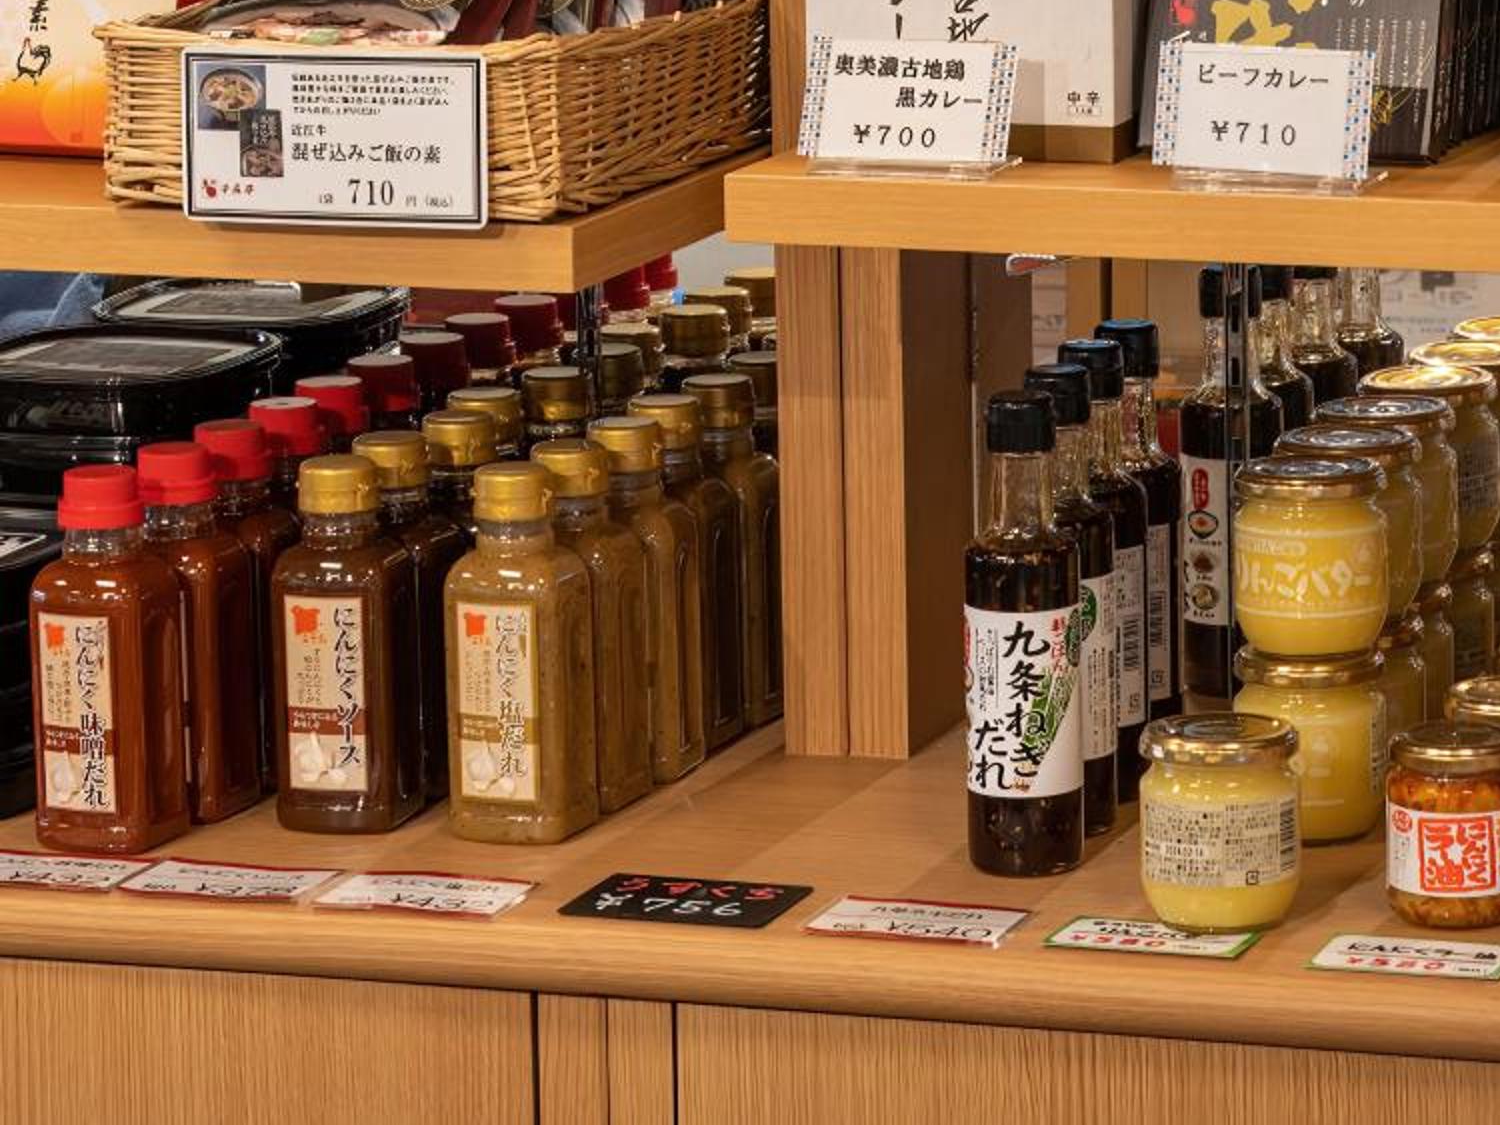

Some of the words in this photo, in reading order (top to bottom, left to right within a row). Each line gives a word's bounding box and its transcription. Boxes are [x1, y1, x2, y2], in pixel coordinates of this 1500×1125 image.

[835, 53, 965, 80] 奥美濃古地鶏
[1199, 64, 1329, 88] ビーフカレー
[895, 87, 983, 108] 黒カレー
[1067, 91, 1100, 105] 中辛
[291, 124, 326, 136] 近江牛
[853, 124, 936, 149] ¥700
[1211, 121, 1296, 146] ¥710
[291, 143, 441, 164] 混ぜ込みご飯の素
[348, 180, 394, 206] 710
[334, 607, 360, 764] にんにくソース
[496, 615, 525, 774] にんにく塩だれ
[1003, 621, 1050, 777] 九条ねぎ
[76, 625, 106, 807] にんにく味噌だれ
[975, 718, 1011, 789] だれ
[1455, 821, 1488, 884] にんにく
